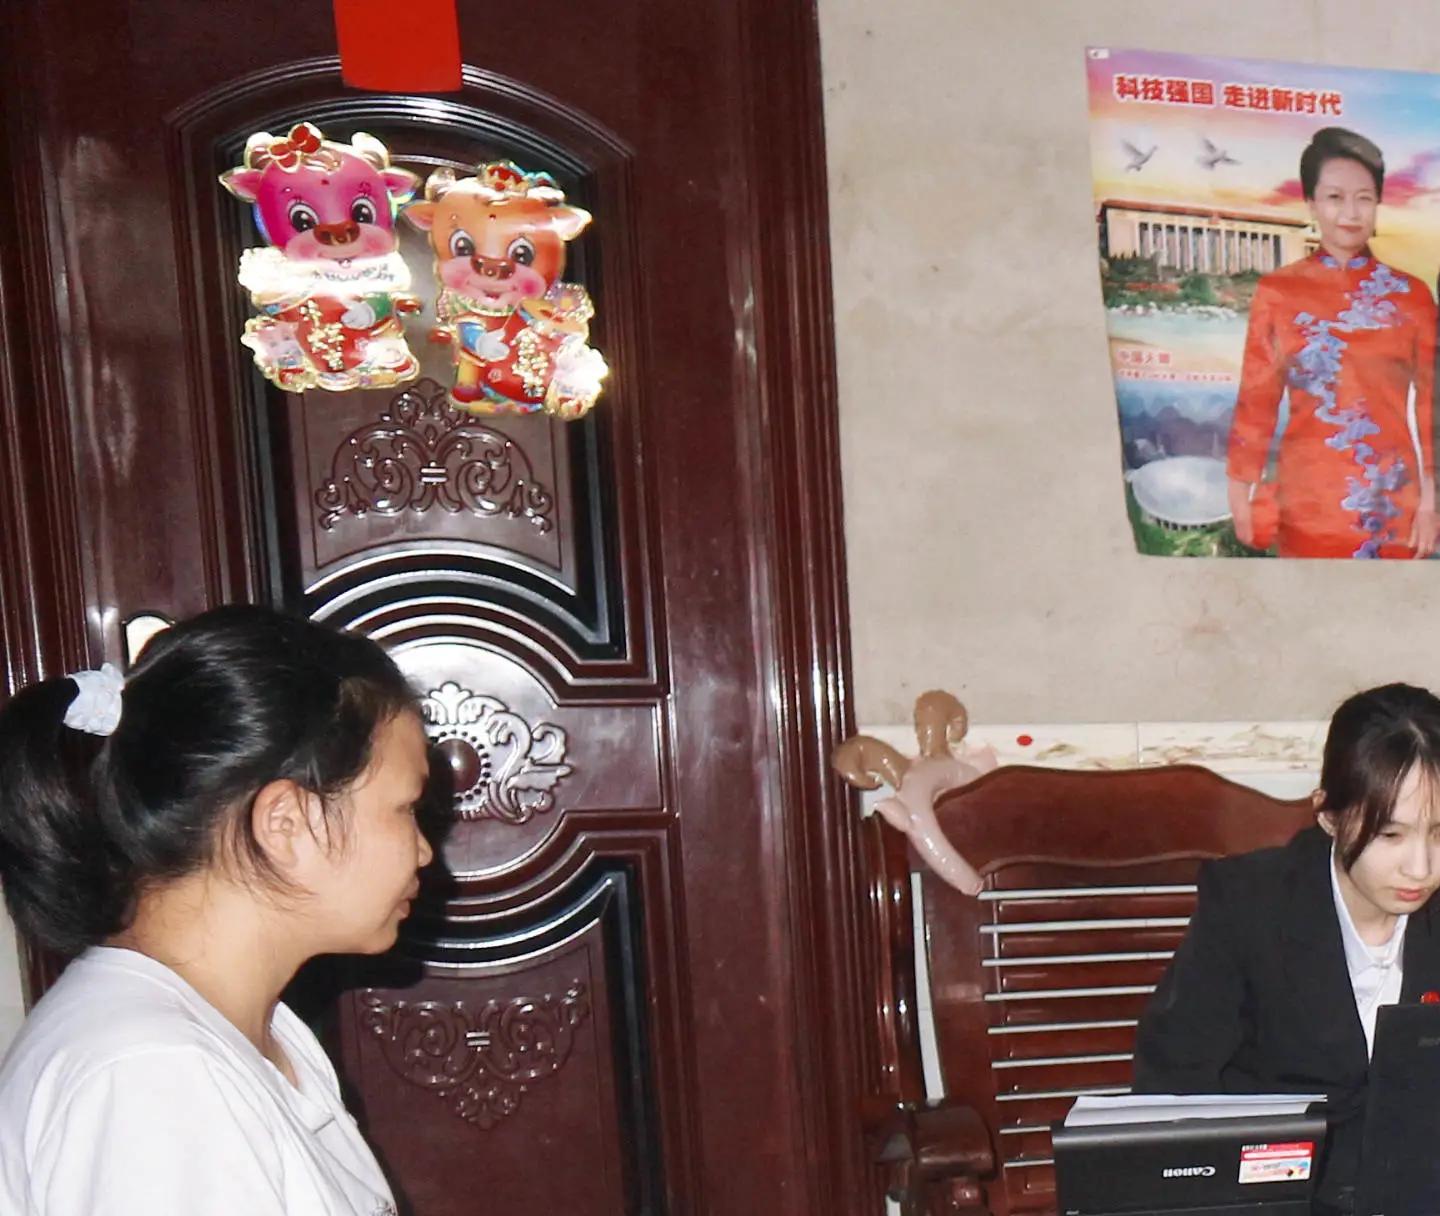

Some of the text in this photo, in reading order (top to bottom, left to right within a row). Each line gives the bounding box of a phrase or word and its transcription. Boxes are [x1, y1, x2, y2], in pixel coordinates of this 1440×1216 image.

[1115, 75, 1342, 116] 科技强国 走进新时代
[1163, 1166, 1217, 1179] Canon
